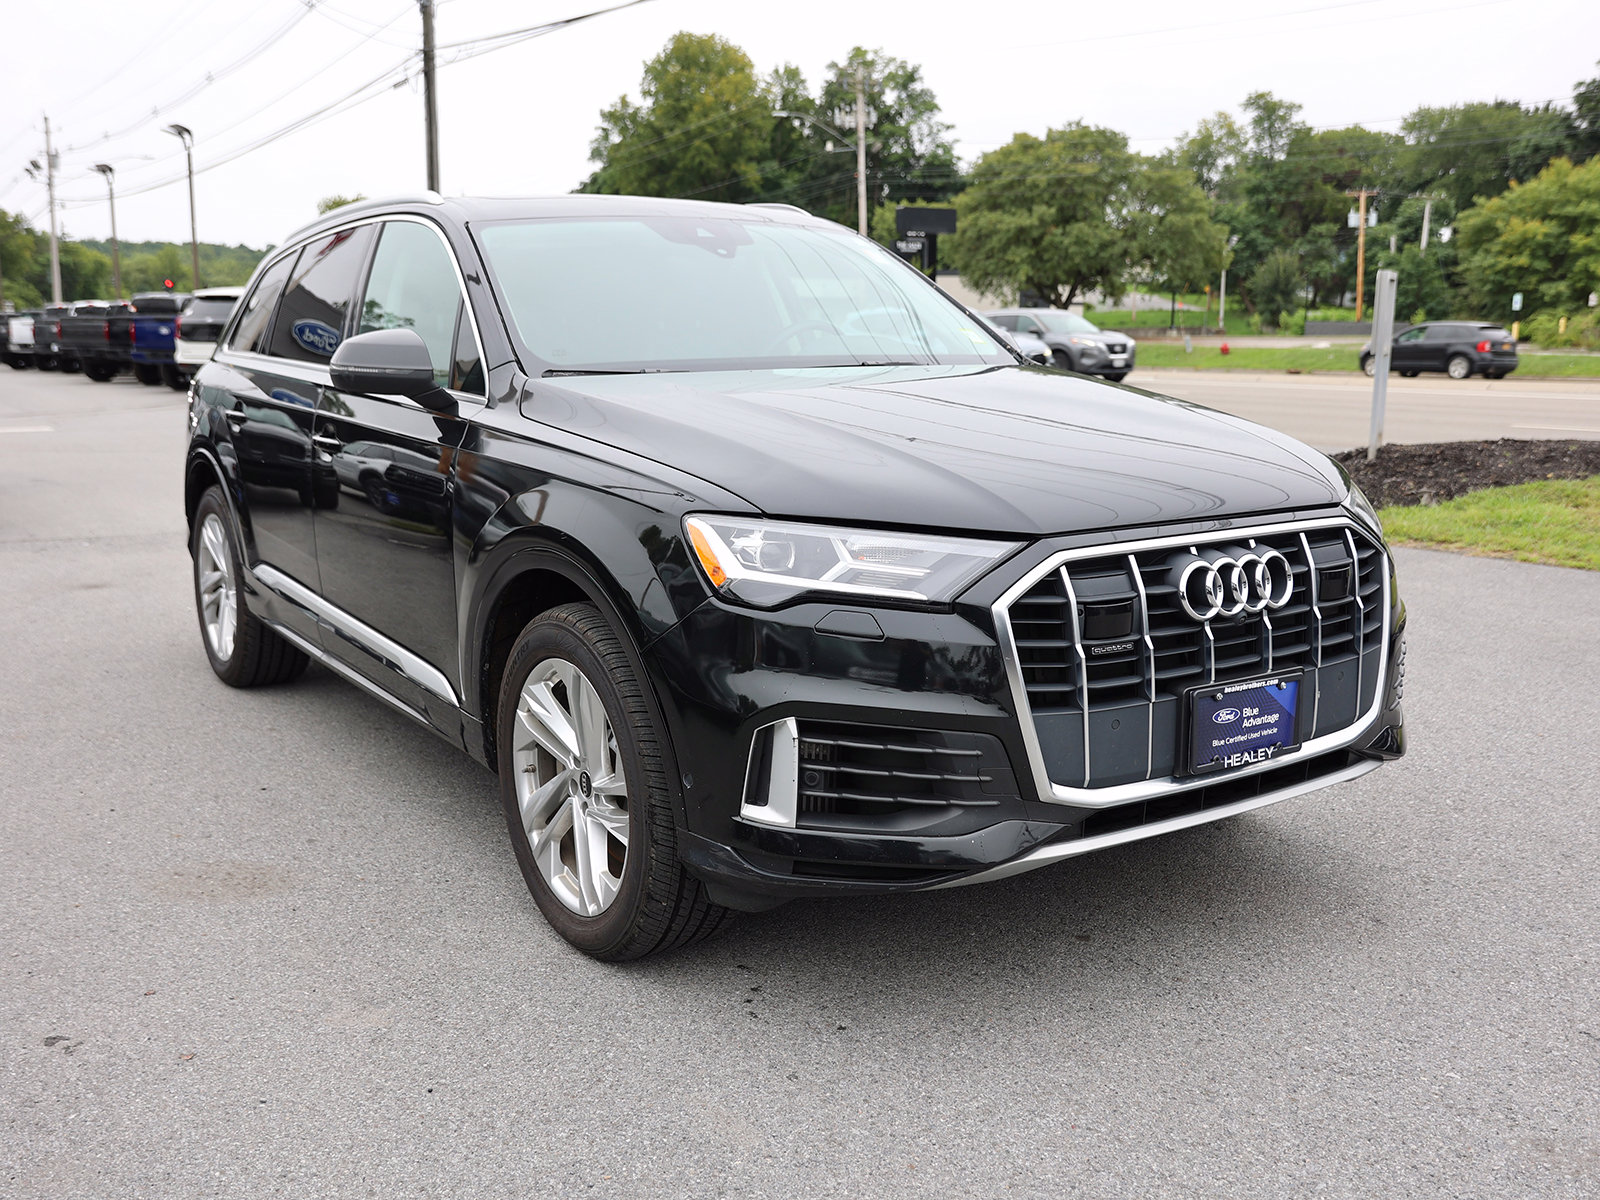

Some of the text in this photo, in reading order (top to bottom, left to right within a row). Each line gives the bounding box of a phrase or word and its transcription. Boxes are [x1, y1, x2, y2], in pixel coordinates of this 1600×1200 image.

[1094, 643, 1132, 655] quattro
[1224, 679, 1279, 694] healeybrothers.com
[1242, 707, 1260, 718] Blue
[1242, 713, 1280, 729] Advantage
[1212, 726, 1278, 747] Blue Certified Used Vehicle
[1224, 746, 1275, 769] HEALEY
